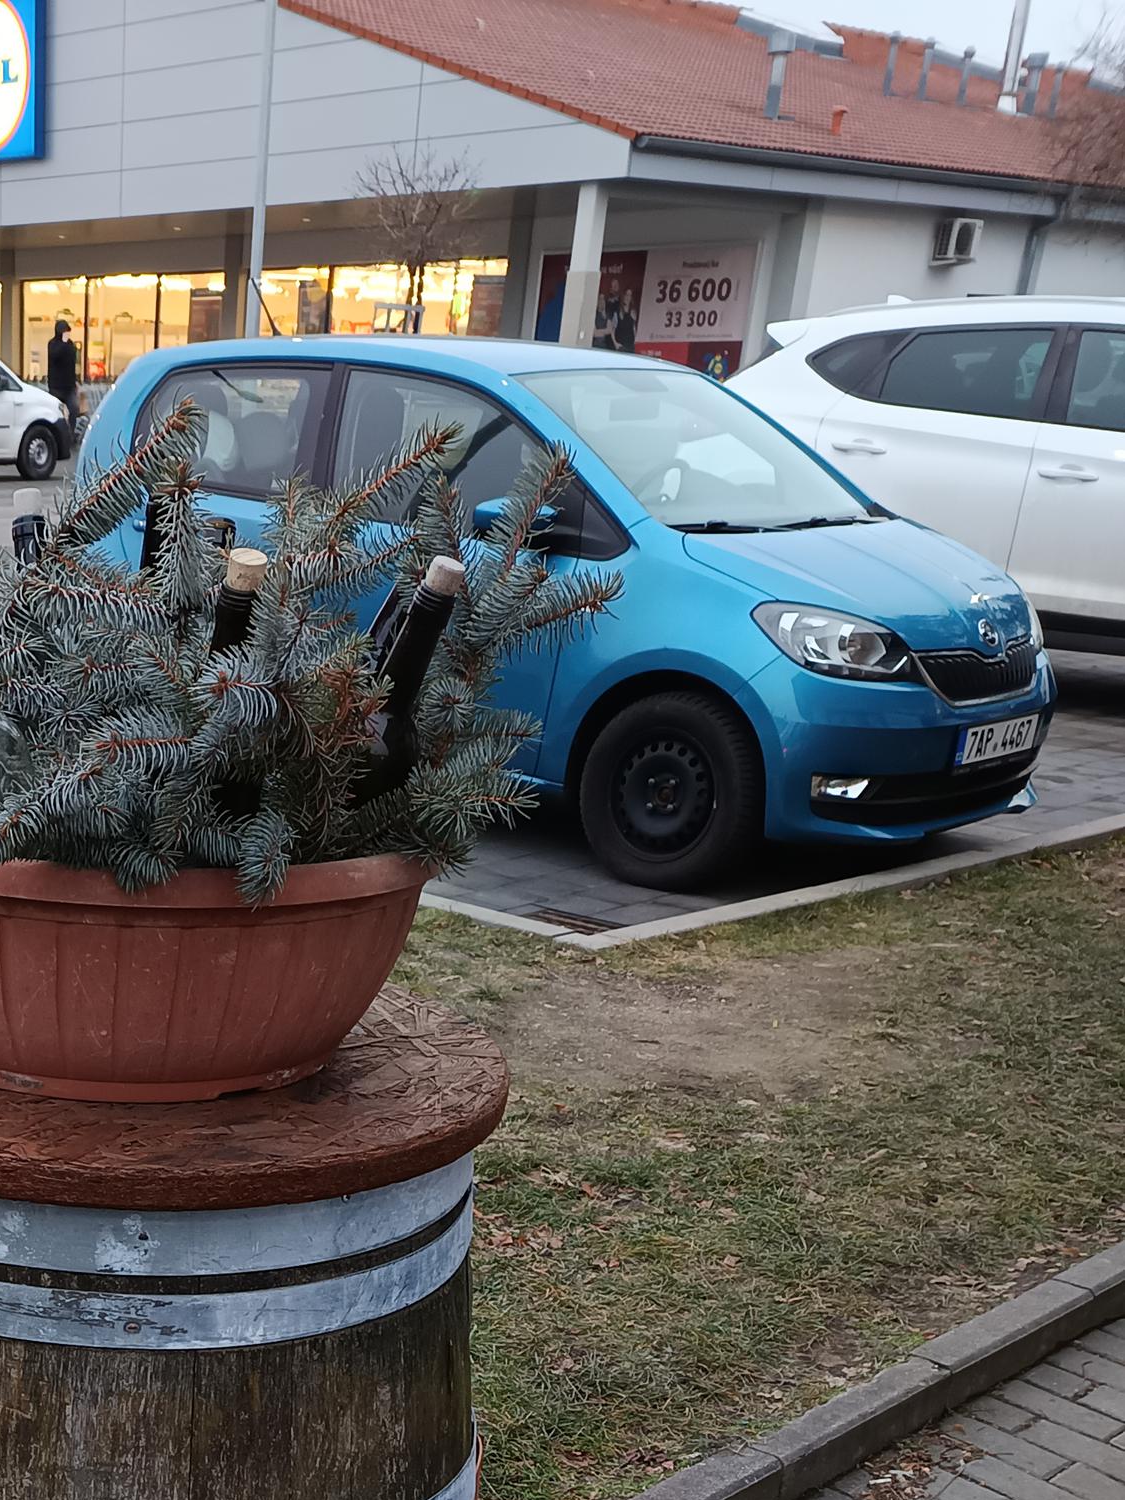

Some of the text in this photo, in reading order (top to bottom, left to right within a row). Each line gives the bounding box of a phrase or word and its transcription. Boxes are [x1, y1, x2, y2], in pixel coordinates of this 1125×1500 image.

[655, 279, 682, 304] 36
[687, 277, 733, 303] 600
[664, 310, 718, 328] 33 300
[966, 719, 1033, 761] 7AP 4467
